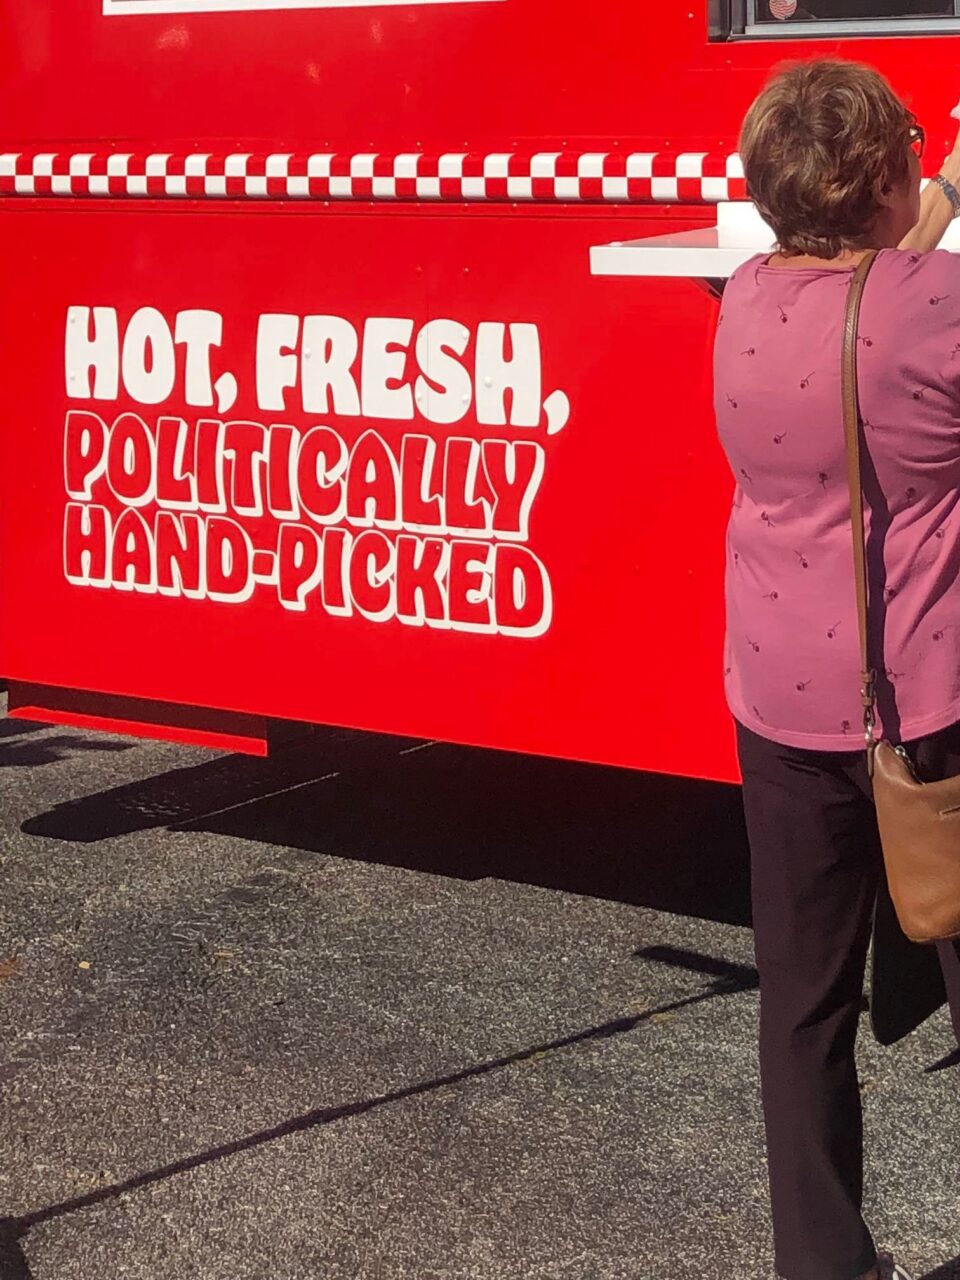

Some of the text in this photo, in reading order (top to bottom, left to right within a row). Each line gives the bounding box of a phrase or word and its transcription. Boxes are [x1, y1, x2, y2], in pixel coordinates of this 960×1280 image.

[64, 305, 571, 436] HOT, FRESH,
[63, 410, 546, 541] POLITICALLY
[63, 503, 553, 639] HAND-PICKED
